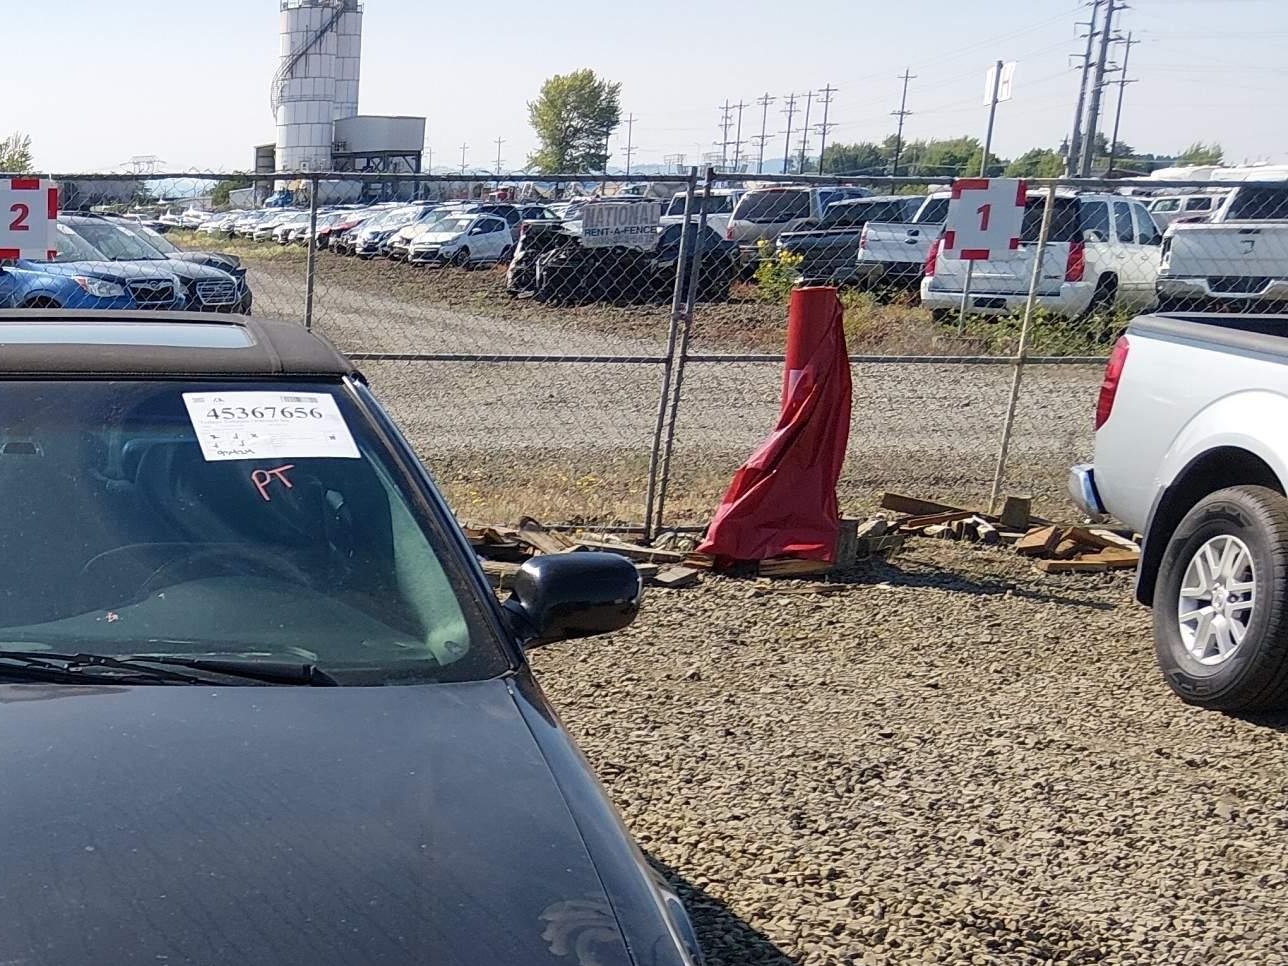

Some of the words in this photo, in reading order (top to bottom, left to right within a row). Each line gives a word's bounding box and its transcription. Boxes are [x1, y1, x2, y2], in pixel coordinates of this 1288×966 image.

[9, 203, 30, 231] 2
[585, 204, 659, 226] NATIONAL
[976, 204, 992, 231] 1
[584, 226, 657, 237] RENT-A-FENCE
[206, 406, 323, 421] 45367656
[251, 464, 295, 501] PT
